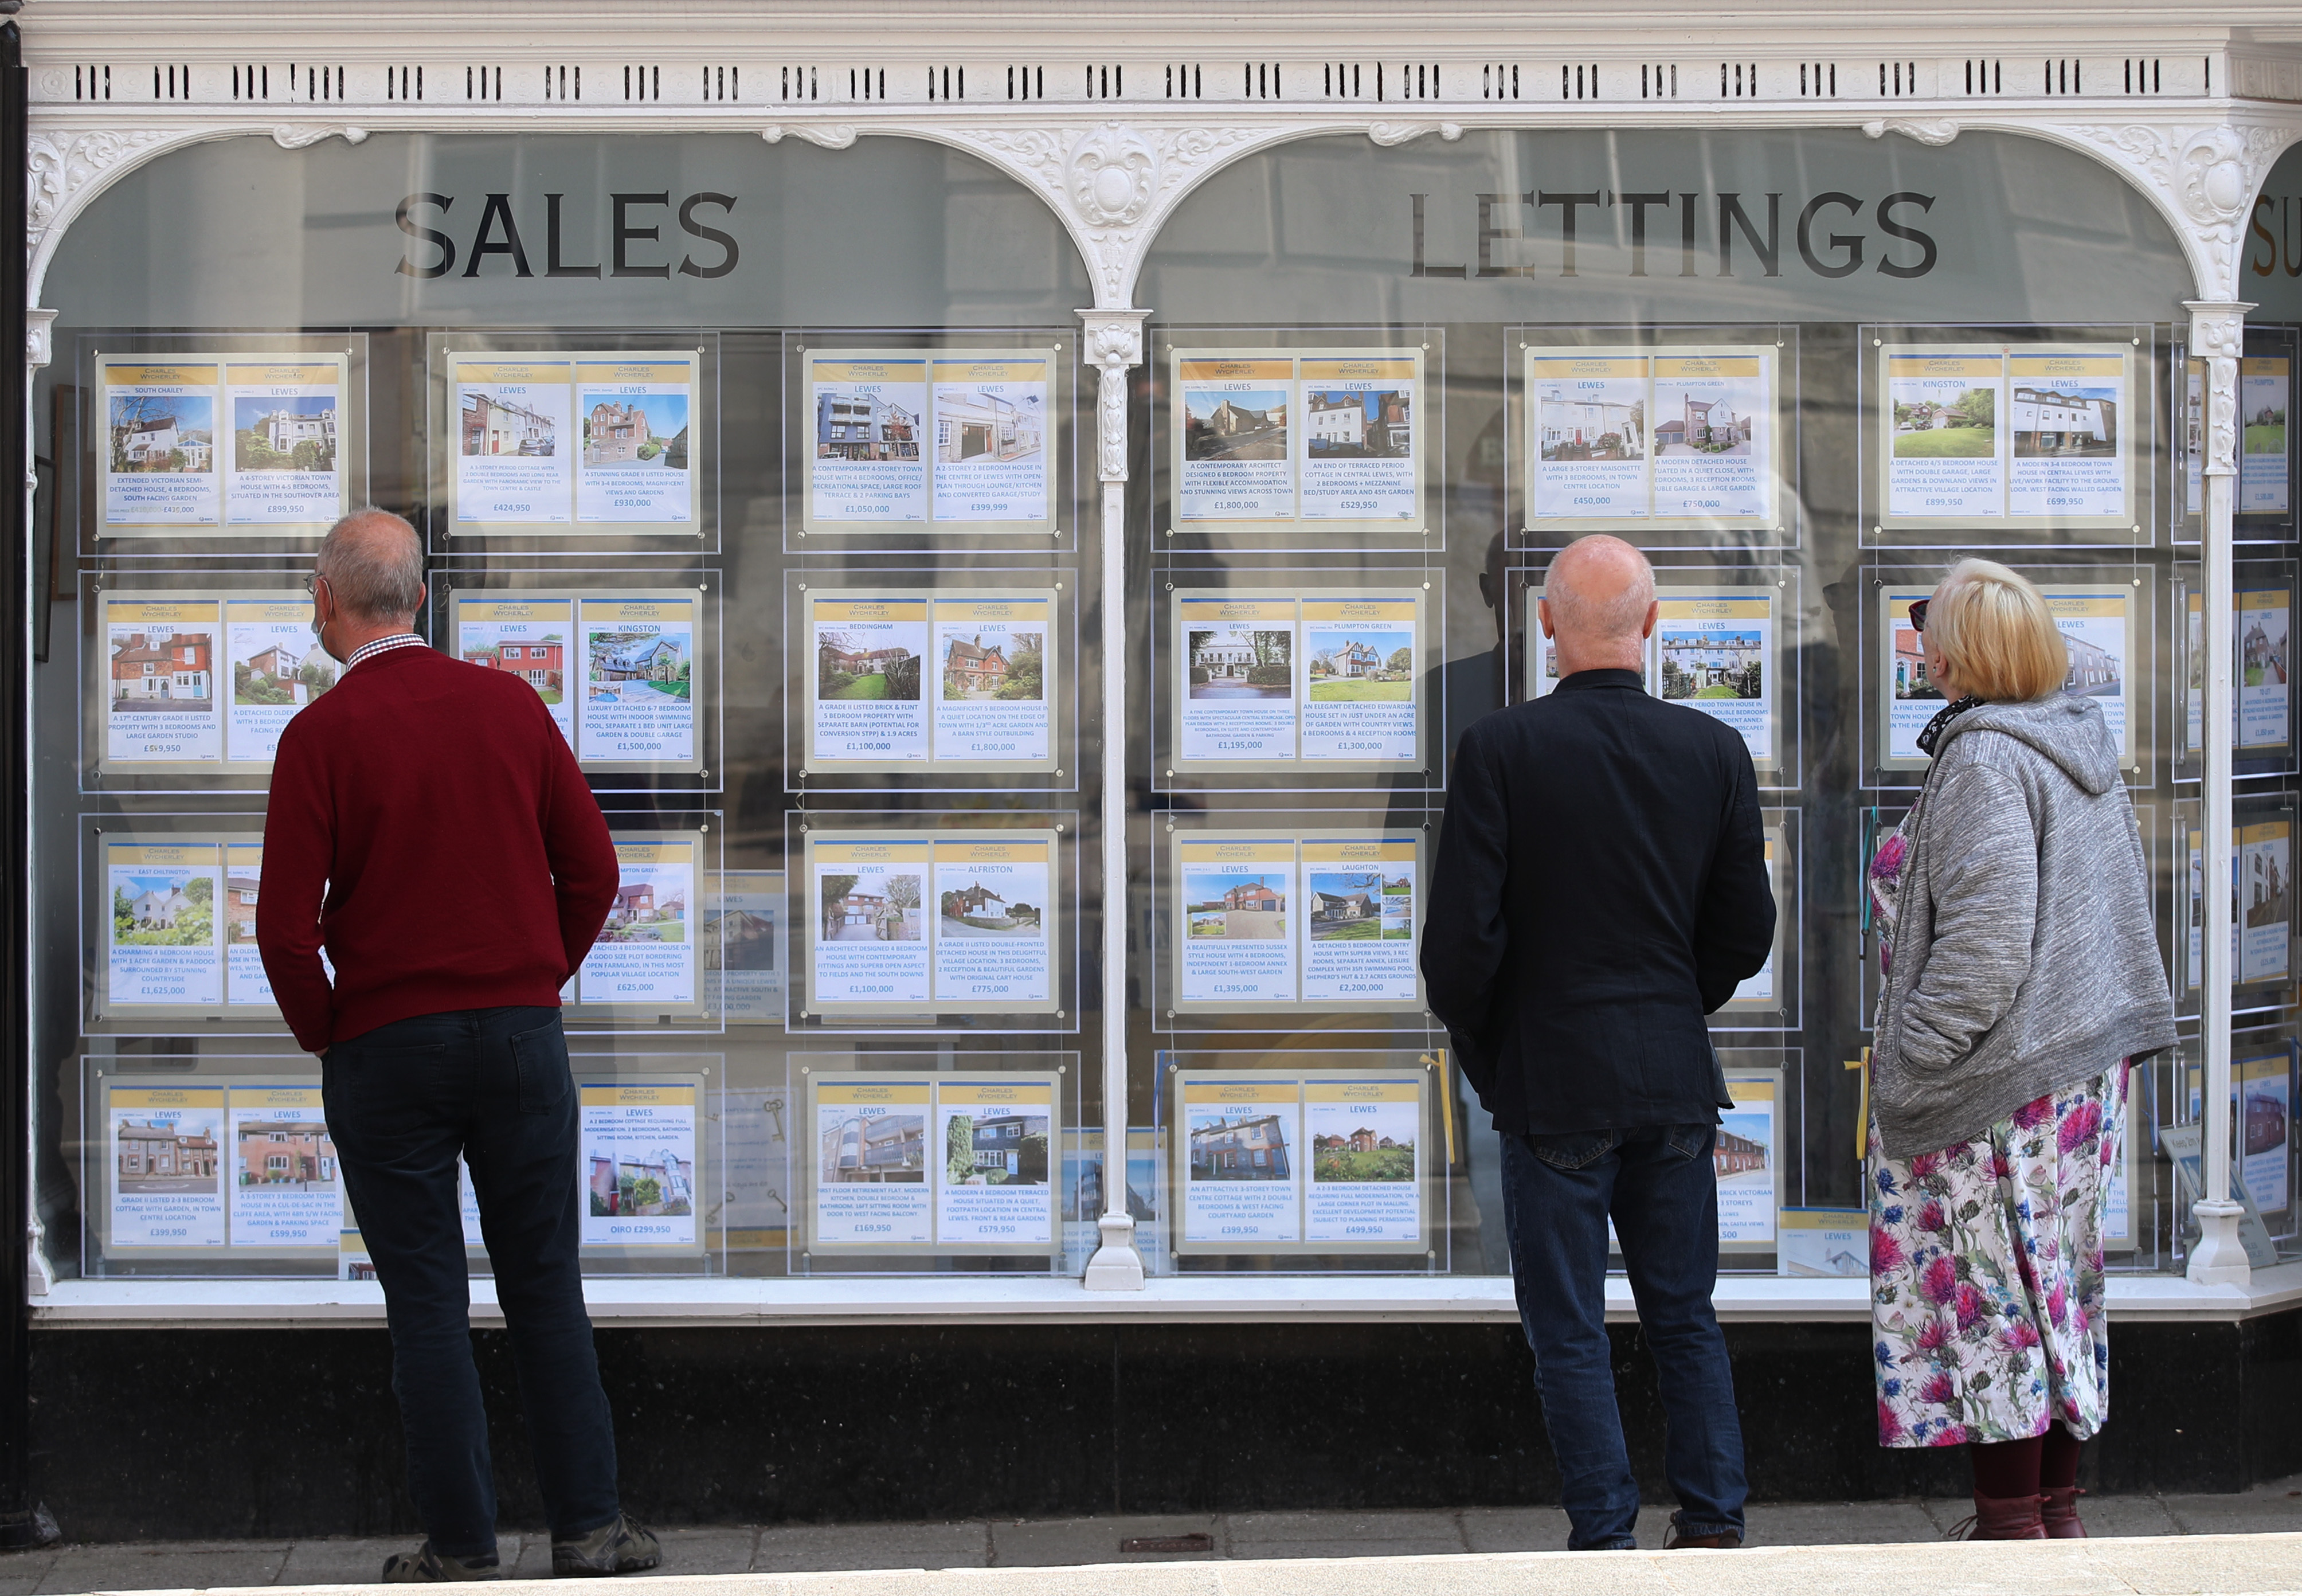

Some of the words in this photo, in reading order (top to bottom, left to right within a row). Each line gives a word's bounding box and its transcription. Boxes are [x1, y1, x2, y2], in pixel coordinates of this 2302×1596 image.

[394, 190, 739, 280] SALES
[1410, 190, 1937, 280] LETTINGS
[2252, 194, 2302, 277] SU
[1224, 383, 1251, 391] LEWES
[1345, 382, 1372, 390] LEWES
[1577, 381, 1605, 389] LEWES
[1923, 380, 1966, 388] KINGSTON
[2051, 380, 2078, 388] LEWES
[271, 388, 298, 396] LEWES
[499, 386, 526, 394] LEWES
[620, 386, 647, 394] LEWES
[614, 499, 651, 508] £930,000
[1214, 501, 1259, 510] £1,800,000
[1340, 501, 1378, 510] £529,950
[1573, 496, 1611, 506] £450,000
[1682, 500, 1720, 508] £750,000
[1925, 498, 1963, 507] £899,950
[2046, 498, 2084, 506] £699,950
[267, 505, 304, 514] £899,950
[494, 504, 531, 513] £424,950
[845, 505, 890, 514] £1,050,000
[971, 503, 1008, 512] £399,999
[2260, 612, 2272, 620] LEWES
[979, 624, 1006, 632] LEWES
[2057, 620, 2085, 628] LEWES
[147, 625, 175, 633] LEWES
[617, 742, 661, 752] £1,500,000
[846, 742, 891, 751] £1,100,000
[971, 743, 1016, 752] £1,800,000
[1218, 741, 1263, 750] £1,195,000
[1337, 742, 1383, 750] £1,300,000
[858, 866, 884, 874] LEWES
[968, 866, 1013, 874] ALFRISTON
[141, 987, 186, 996] £1,625,000
[617, 983, 654, 992] £625,000
[849, 985, 894, 994] £1,100,000
[972, 985, 1009, 994] £775,000
[1213, 984, 1258, 993] £1,395,000
[1339, 984, 1384, 992] £2,200,000
[626, 1109, 653, 1117] LEWES
[859, 1107, 886, 1115] LEWES
[1350, 1105, 1377, 1113] LEWES
[274, 1110, 301, 1118] LEWES
[2171, 1137, 2186, 1149] Keep
[2186, 1136, 2197, 1147] 2m
[150, 1228, 187, 1237] £399,950
[610, 1226, 632, 1234] OIRO
[633, 1226, 671, 1234] £299,950
[854, 1224, 892, 1233] £169,950
[978, 1225, 1016, 1234] £579,950
[1221, 1226, 1259, 1235] £399,950
[1345, 1226, 1383, 1234] £499,950
[270, 1230, 307, 1238] £599,950
